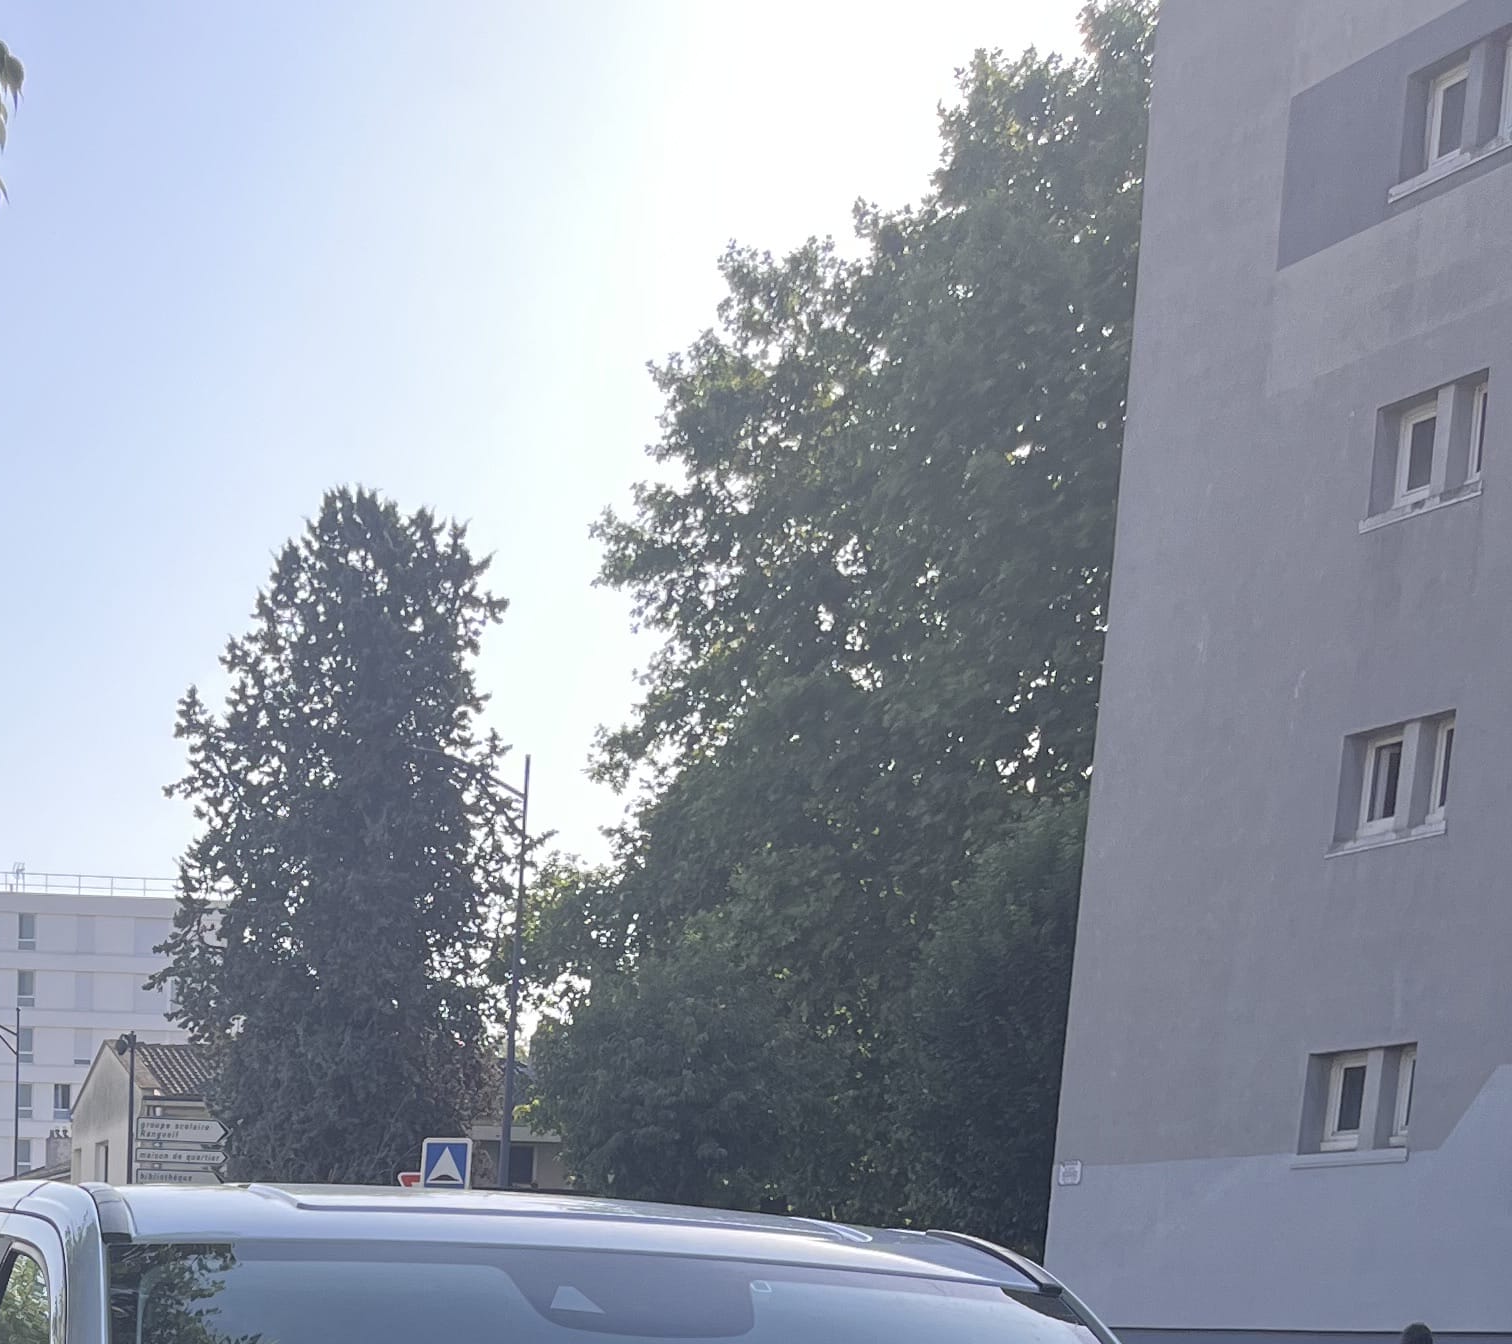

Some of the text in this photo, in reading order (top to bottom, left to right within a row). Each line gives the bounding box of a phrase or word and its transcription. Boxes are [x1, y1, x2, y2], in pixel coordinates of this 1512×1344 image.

[140, 1121, 210, 1131] groupe scolaire
[139, 1152, 220, 1162] maison de quartier
